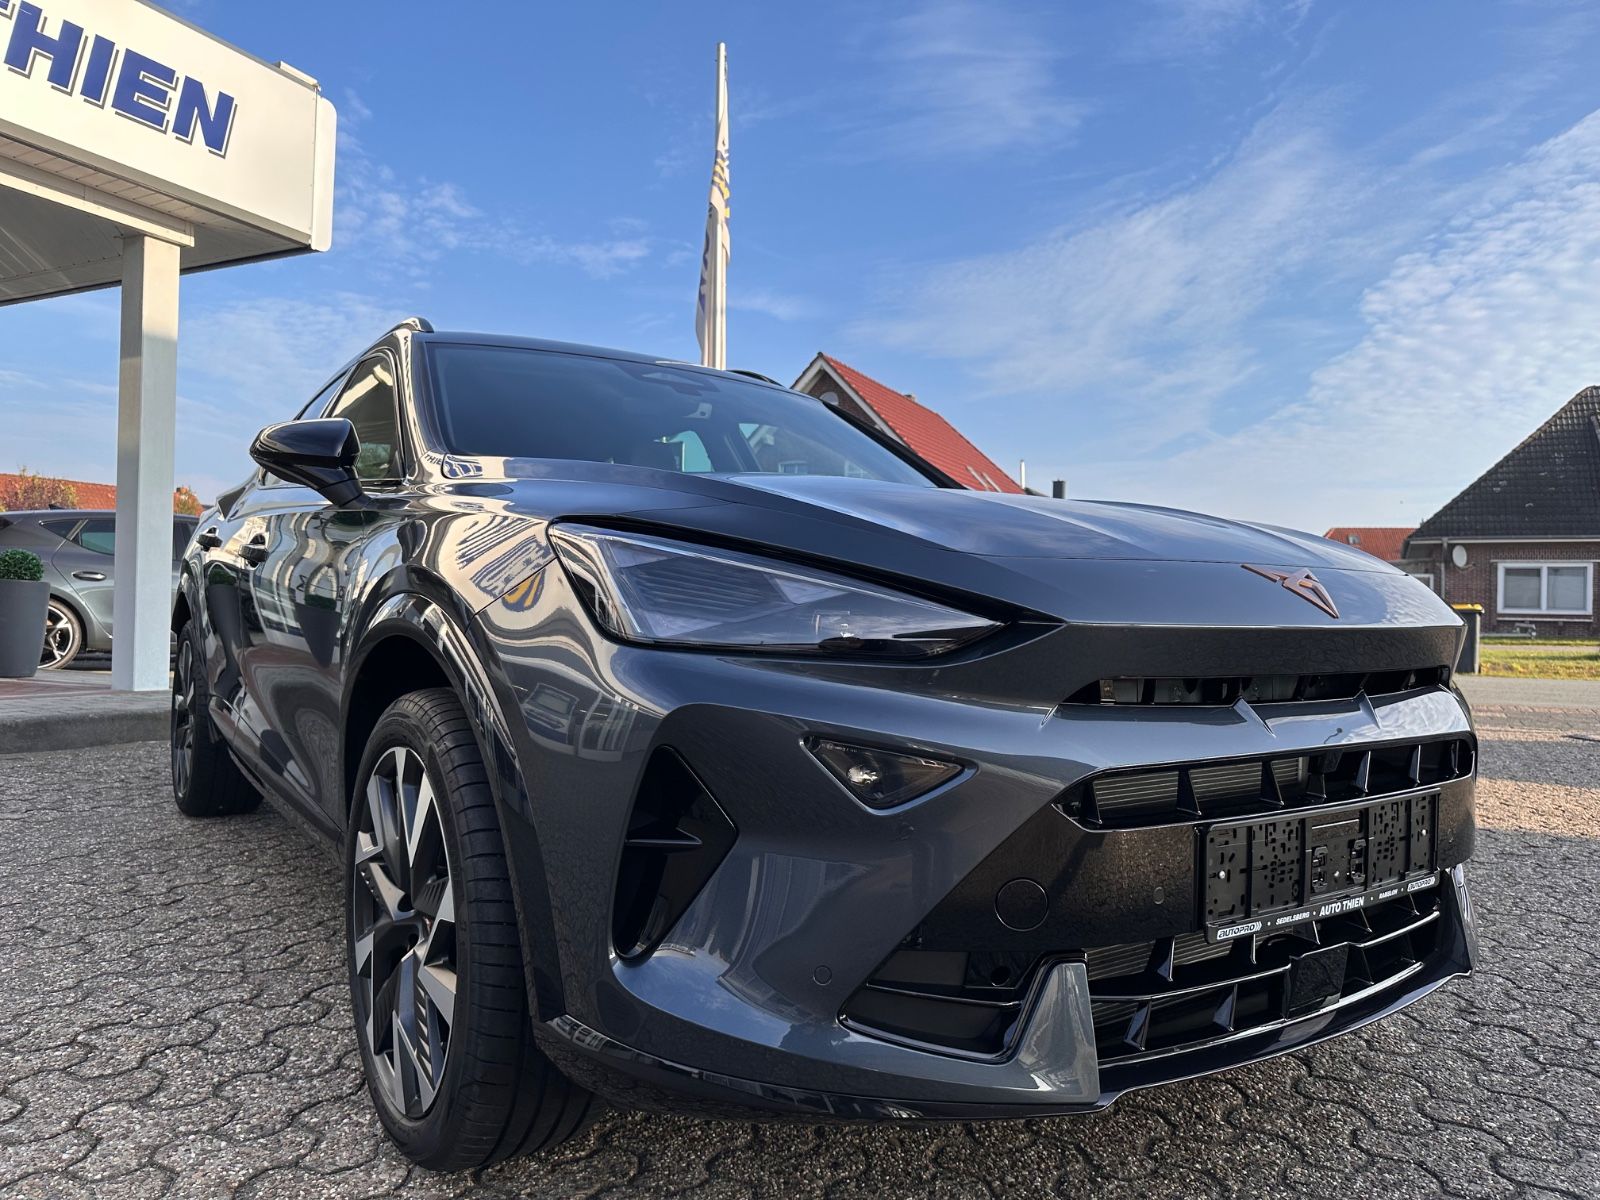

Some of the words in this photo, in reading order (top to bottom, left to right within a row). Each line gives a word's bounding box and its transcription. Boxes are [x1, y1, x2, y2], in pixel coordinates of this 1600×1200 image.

[0, 0, 237, 158] HIEN
[1275, 911, 1310, 925] SEDELSBERG
[1319, 902, 1341, 916] AUTO
[1342, 896, 1365, 911] THIEN
